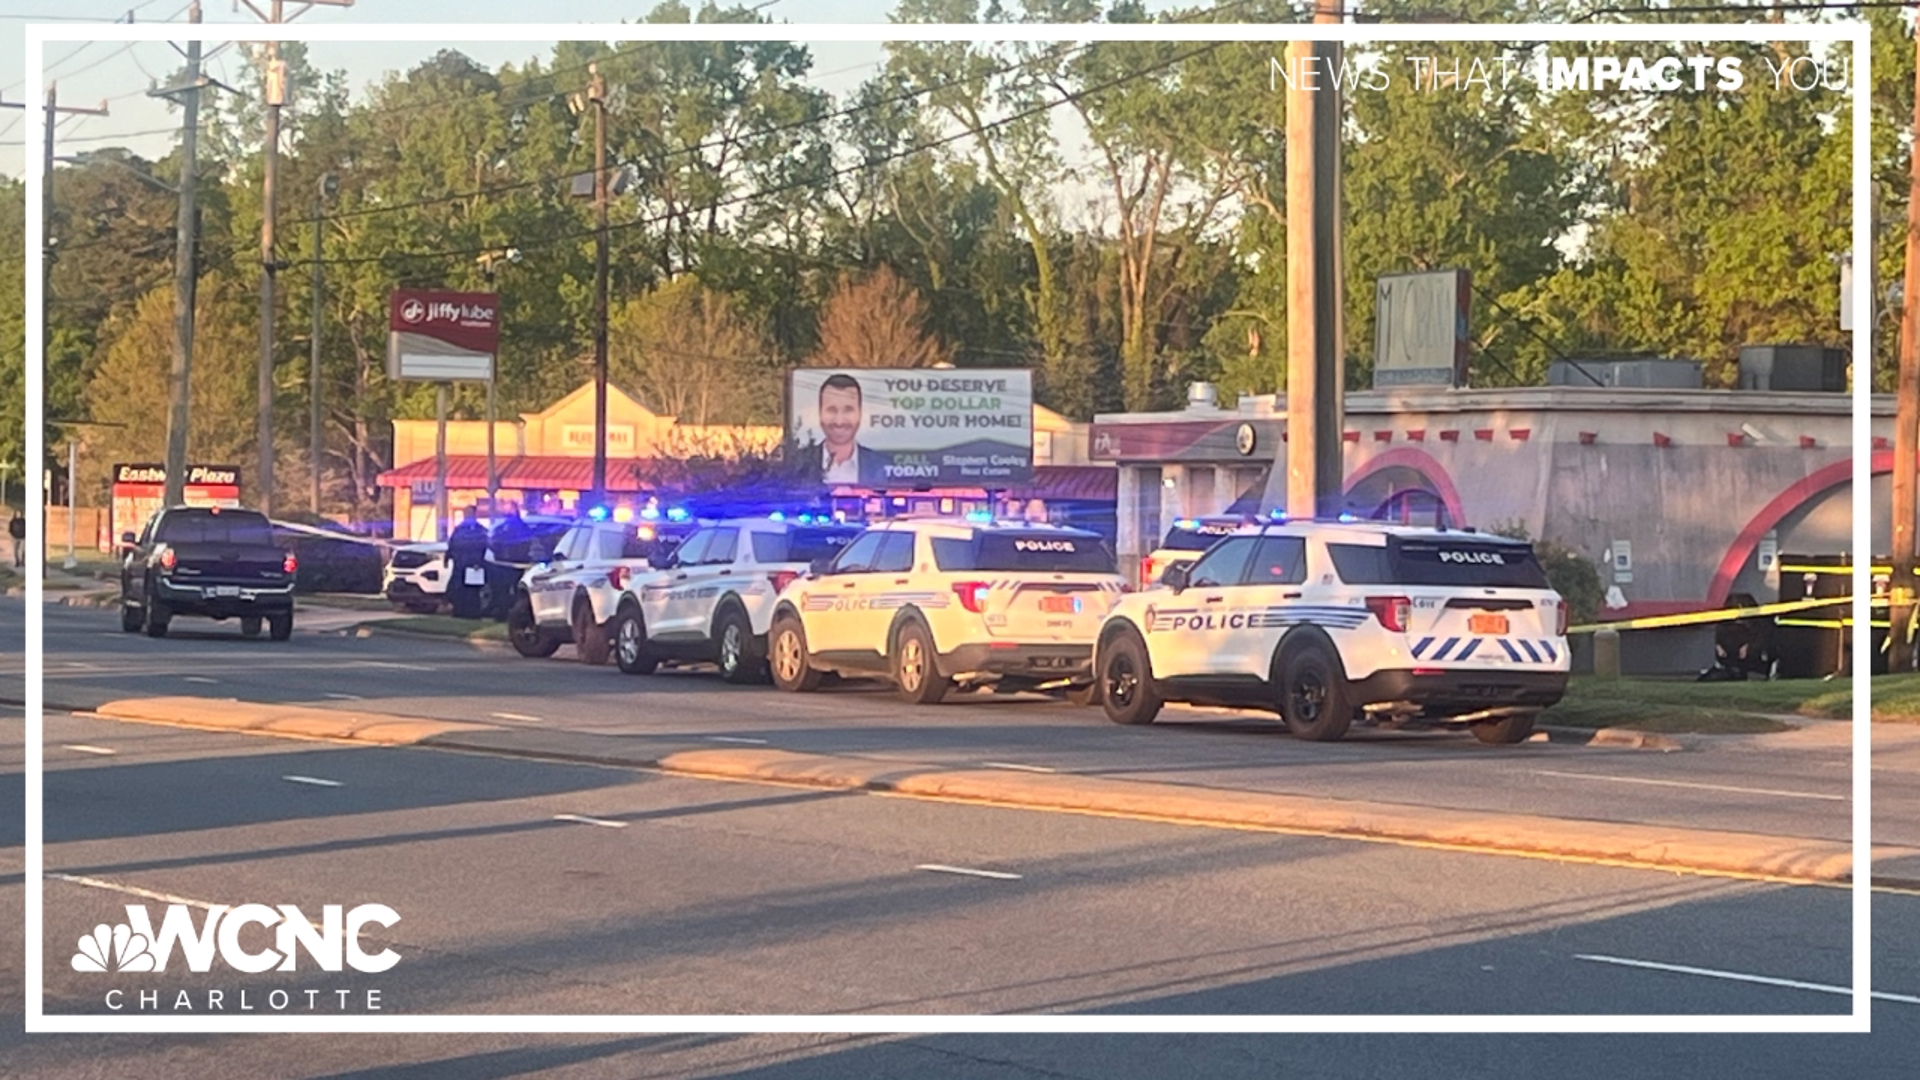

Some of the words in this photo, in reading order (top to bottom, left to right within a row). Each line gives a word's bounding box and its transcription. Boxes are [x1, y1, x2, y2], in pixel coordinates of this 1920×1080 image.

[884, 379, 922, 393] YOU
[927, 379, 1007, 392] DESERVE
[889, 397, 926, 410] TOP
[930, 397, 1002, 411] DOLLAR
[869, 415, 906, 428] FOR
[909, 415, 960, 428] YOUR
[964, 415, 1023, 428] HOME!
[893, 455, 931, 466] CALL
[189, 467, 236, 484] Plaza
[883, 465, 939, 478] TODAY!
[1015, 540, 1075, 552] POLICE
[1438, 552, 1505, 565] POLICE
[1172, 613, 1263, 631] POLICE
